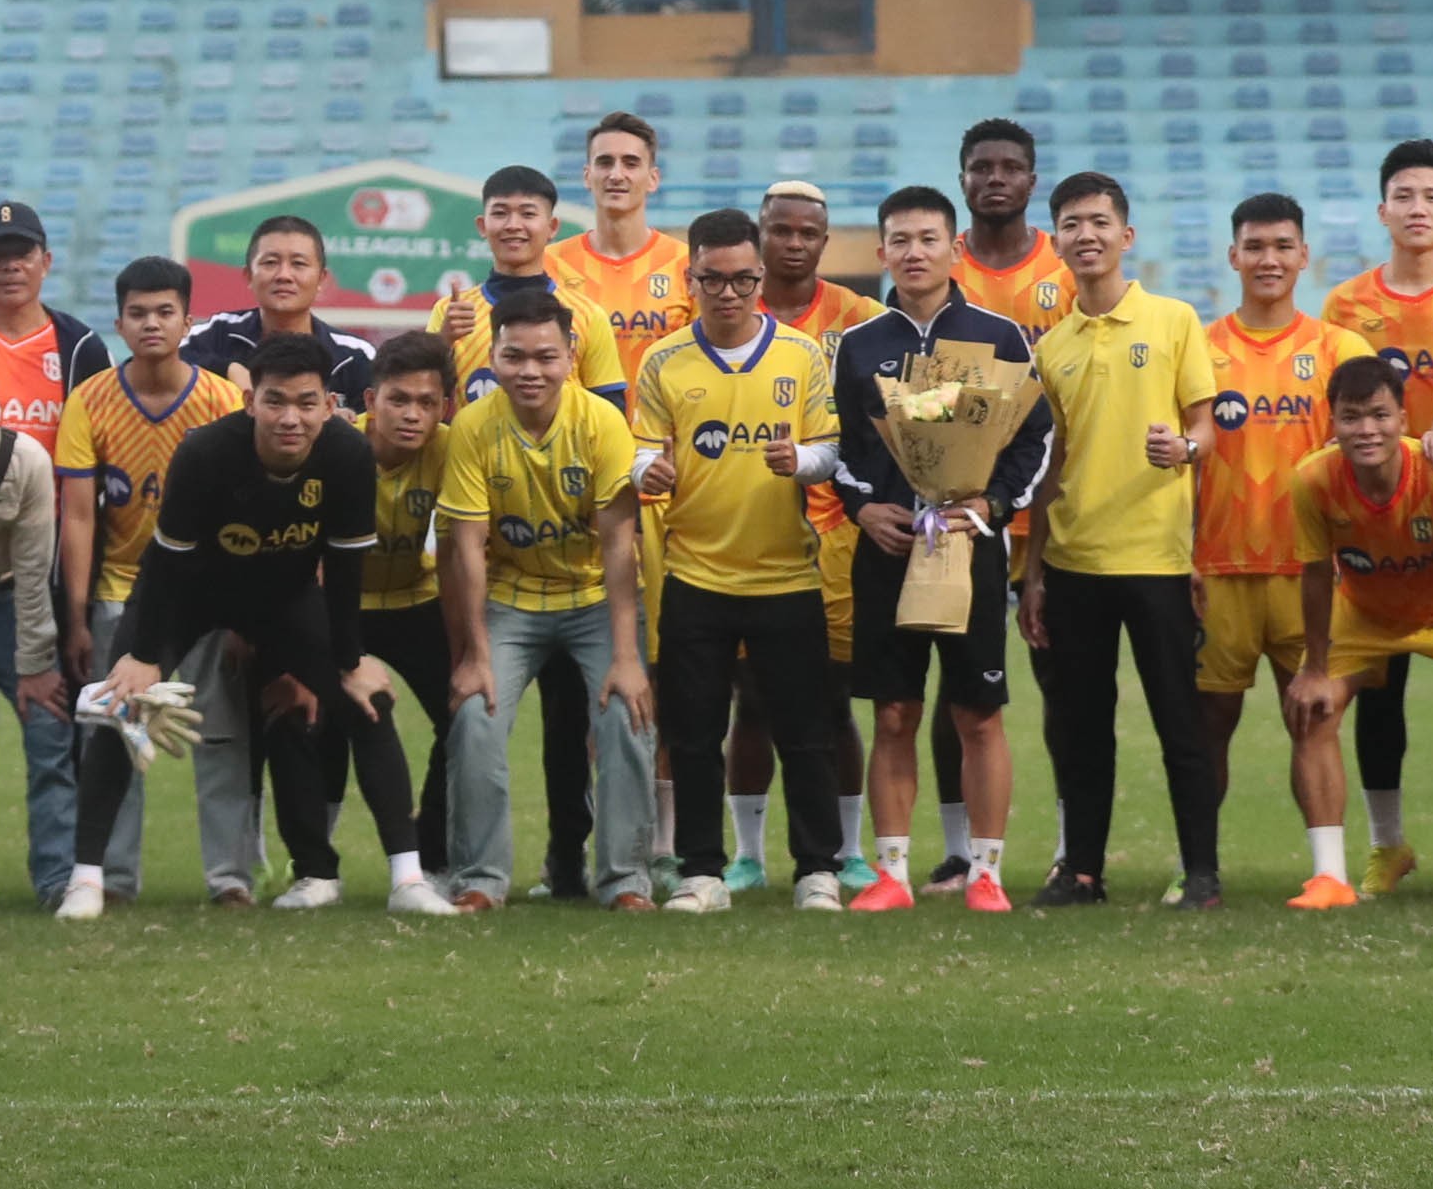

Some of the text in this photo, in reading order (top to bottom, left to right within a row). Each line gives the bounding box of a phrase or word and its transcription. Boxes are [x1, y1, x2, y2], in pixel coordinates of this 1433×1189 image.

[610, 311, 666, 330] AAN
[3, 398, 65, 423] AAN
[1253, 395, 1312, 416] AAN
